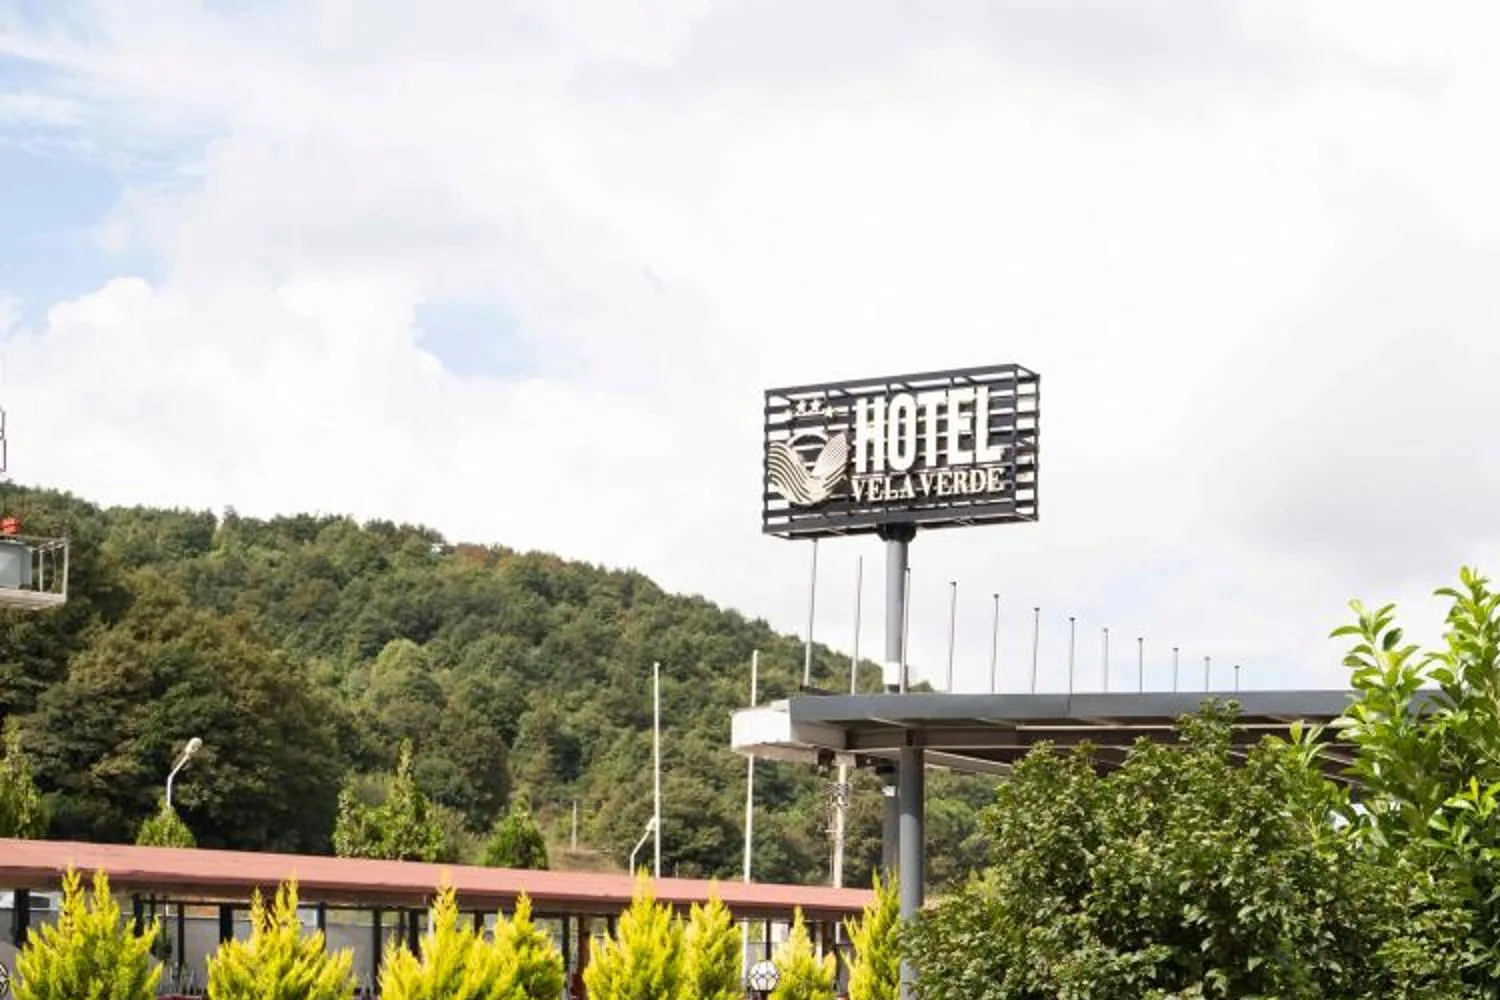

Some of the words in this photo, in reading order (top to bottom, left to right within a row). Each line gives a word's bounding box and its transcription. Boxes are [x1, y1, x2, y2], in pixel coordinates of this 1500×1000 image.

[854, 385, 1004, 473] HOTEL
[851, 474, 916, 502] VELA
[920, 467, 1005, 496] VERDE
